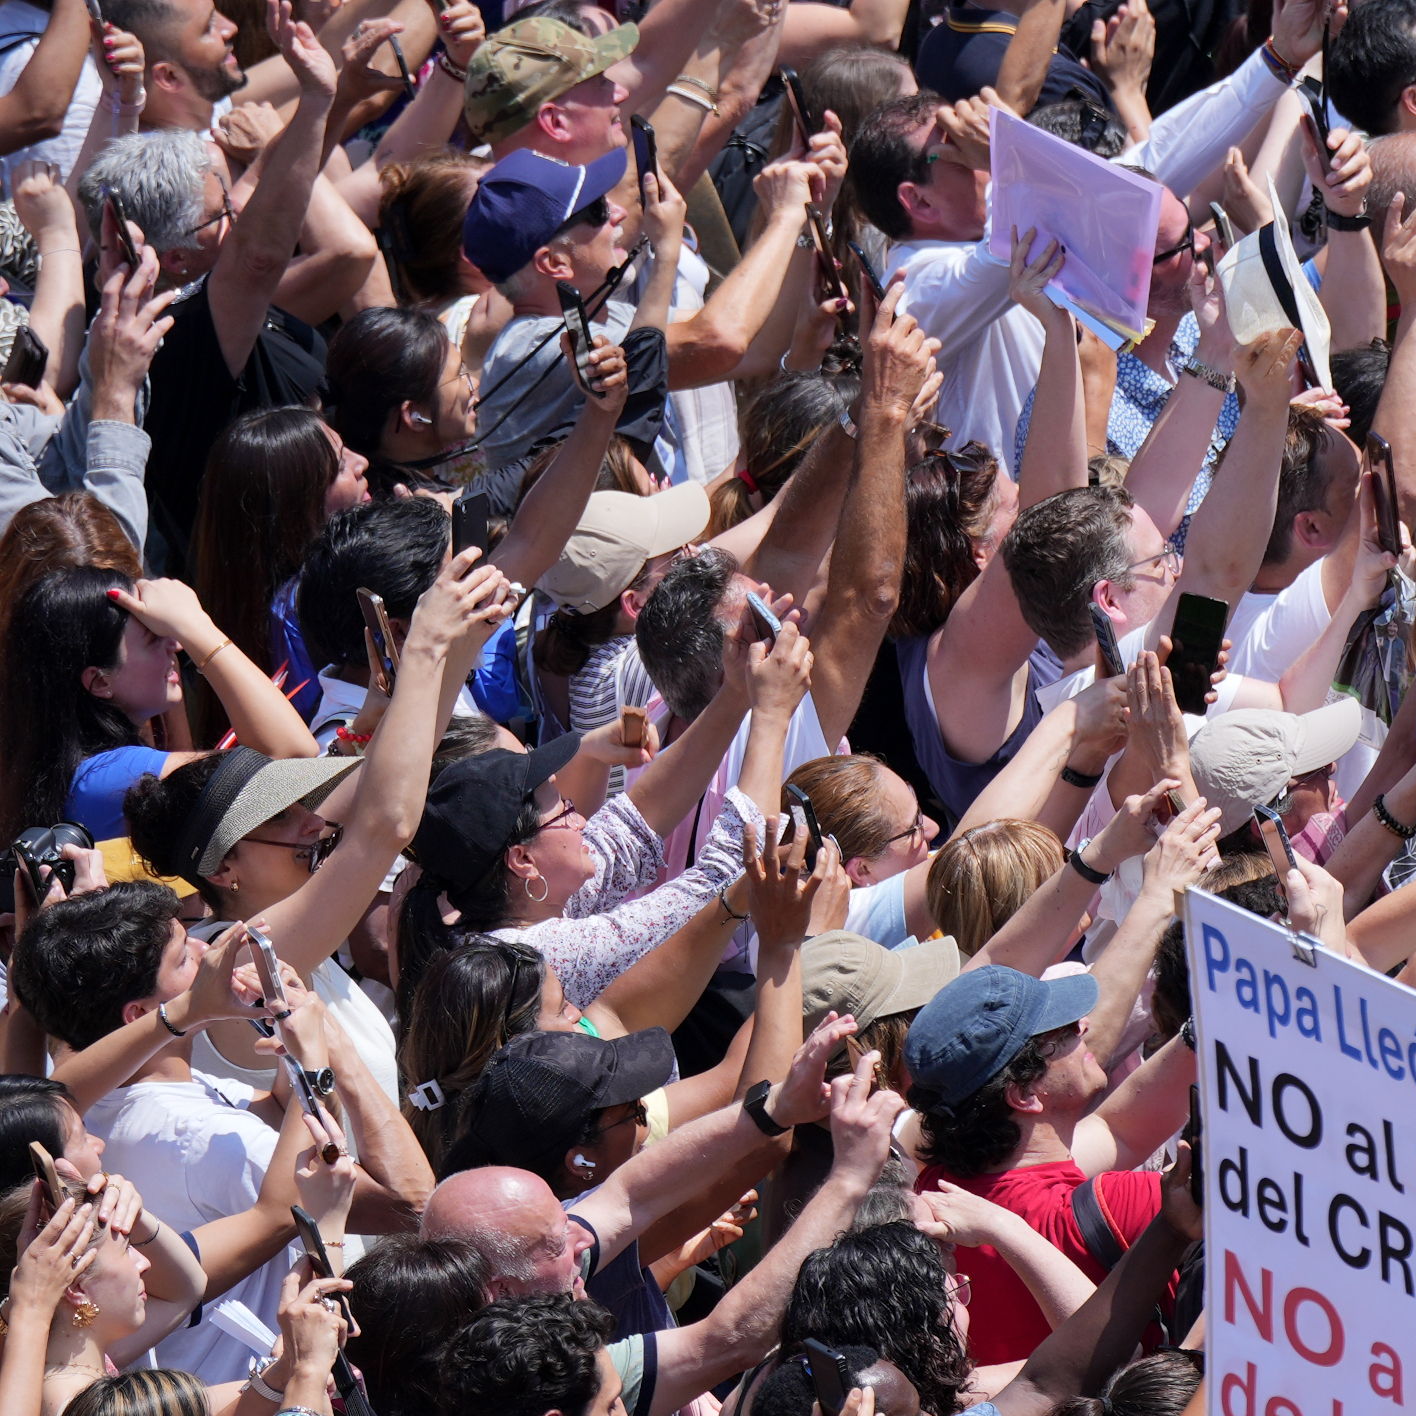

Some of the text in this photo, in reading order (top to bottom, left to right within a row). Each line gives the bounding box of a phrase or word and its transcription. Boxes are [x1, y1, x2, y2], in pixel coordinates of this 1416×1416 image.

[1202, 923, 1321, 1041] Papa
[1214, 1038, 1324, 1149] NO
[1345, 1119, 1404, 1194] al
[1219, 1146, 1310, 1248] del
[1225, 1249, 1344, 1368] NO
[1368, 1342, 1404, 1406] a
